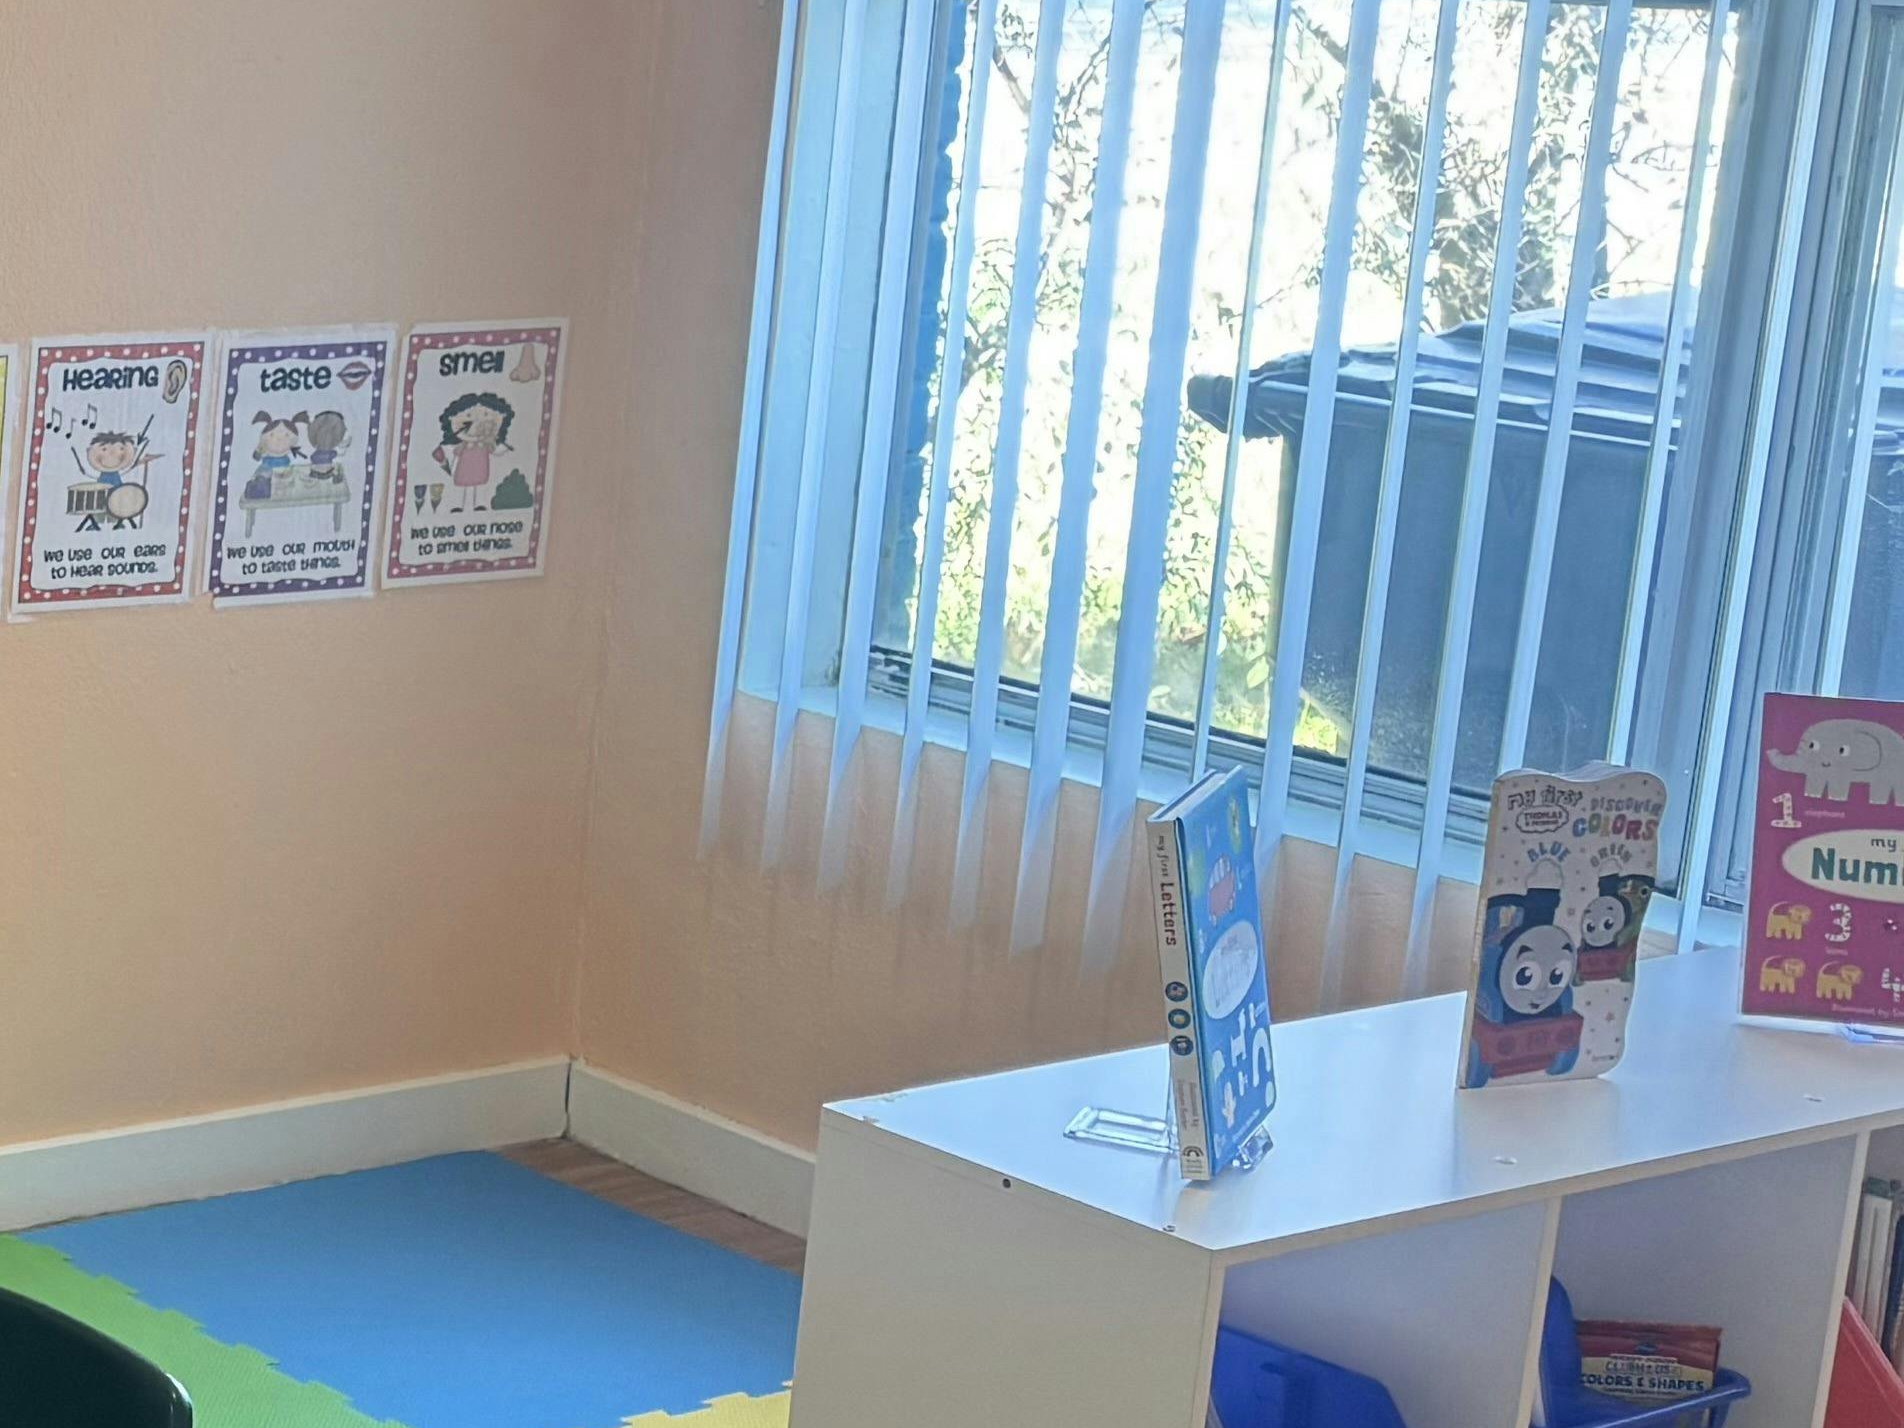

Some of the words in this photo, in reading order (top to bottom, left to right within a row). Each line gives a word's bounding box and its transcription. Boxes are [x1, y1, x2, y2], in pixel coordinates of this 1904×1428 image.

[439, 350, 505, 376] smell
[260, 365, 332, 393] taste
[1771, 792, 1802, 828] 1
[1572, 813, 1659, 841] COLORS
[1527, 841, 1571, 863] BLUE
[1871, 838, 1897, 853] my
[1811, 847, 1904, 886] Num
[1160, 882, 1177, 946] Letters
[1824, 903, 1851, 942] 3
[1648, 1377, 1705, 1391] SHAPES
